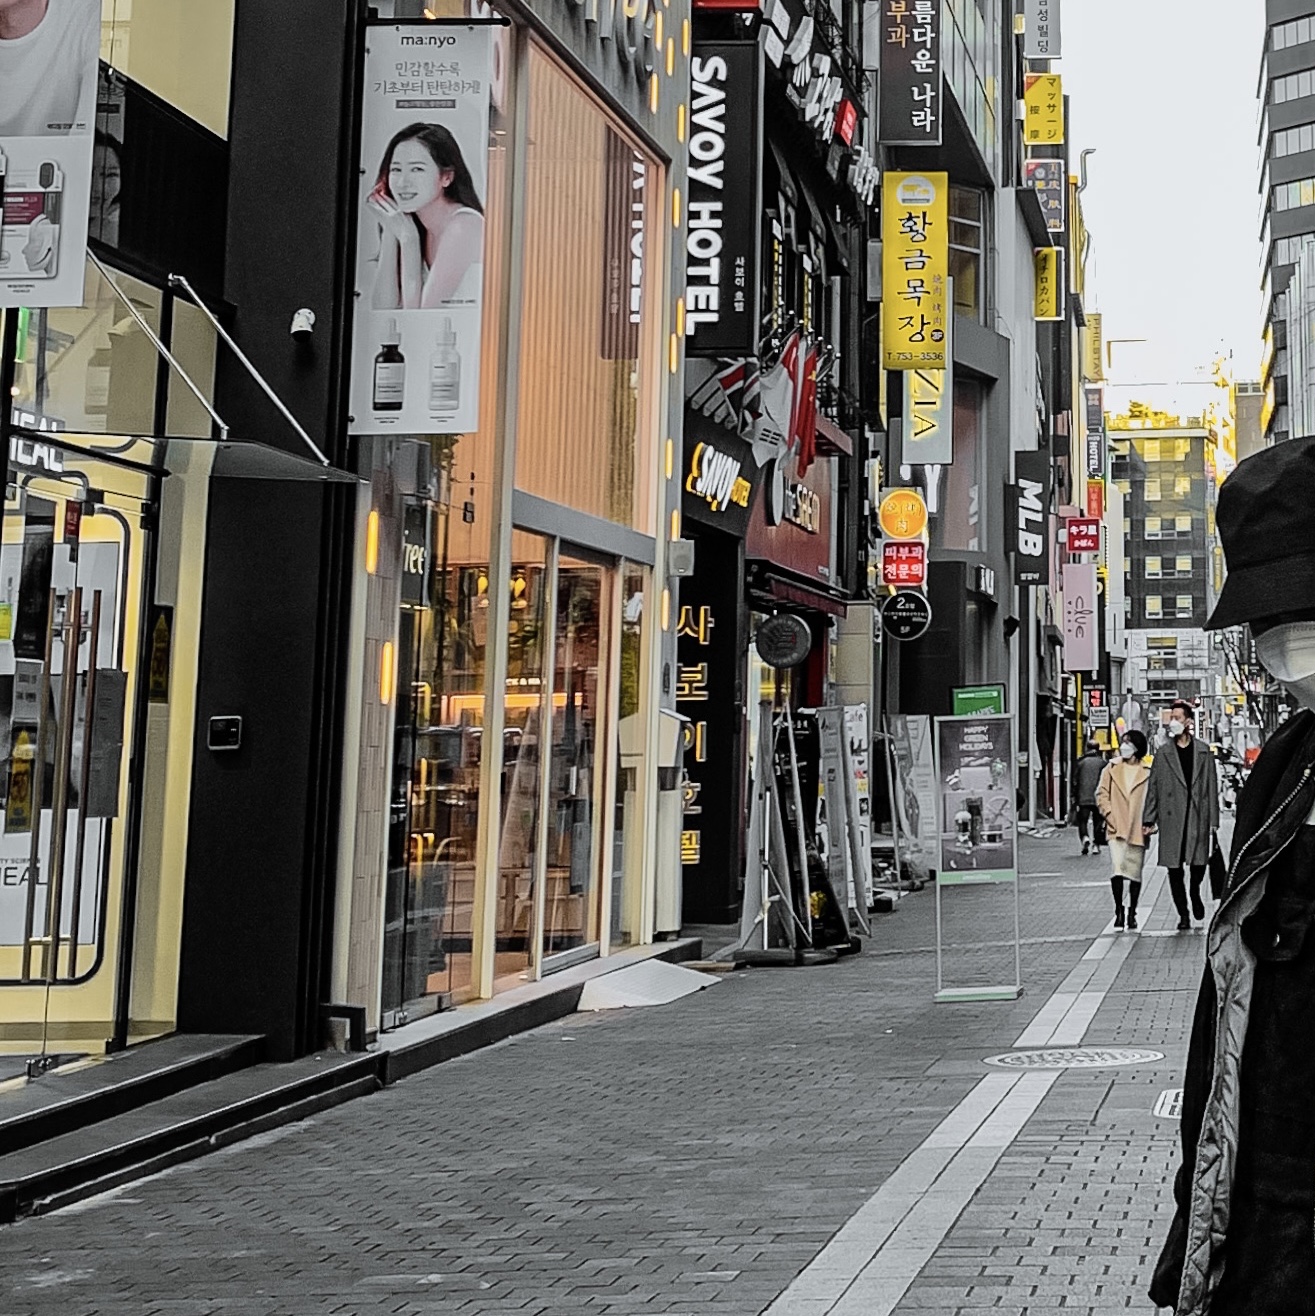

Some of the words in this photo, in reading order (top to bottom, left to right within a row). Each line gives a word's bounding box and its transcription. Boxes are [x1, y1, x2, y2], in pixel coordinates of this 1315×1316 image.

[400, 35, 457, 48] ma:nyo
[910, 1, 936, 73] 름다운
[1037, 0, 1049, 54] 성빌딩
[374, 80, 424, 95] 기초부터
[395, 60, 461, 77] 민감할수록
[685, 55, 728, 190] SAVOY
[910, 82, 936, 133] 나라
[1046, 77, 1058, 140] マッサージ
[685, 201, 723, 336] HOTEL
[896, 210, 934, 343] 황금목장
[696, 444, 741, 512] SAVOY
[1018, 477, 1044, 557] MLB
[884, 545, 924, 561] 피부과
[884, 563, 923, 580] 전문의
[676, 605, 716, 763] 사보이
